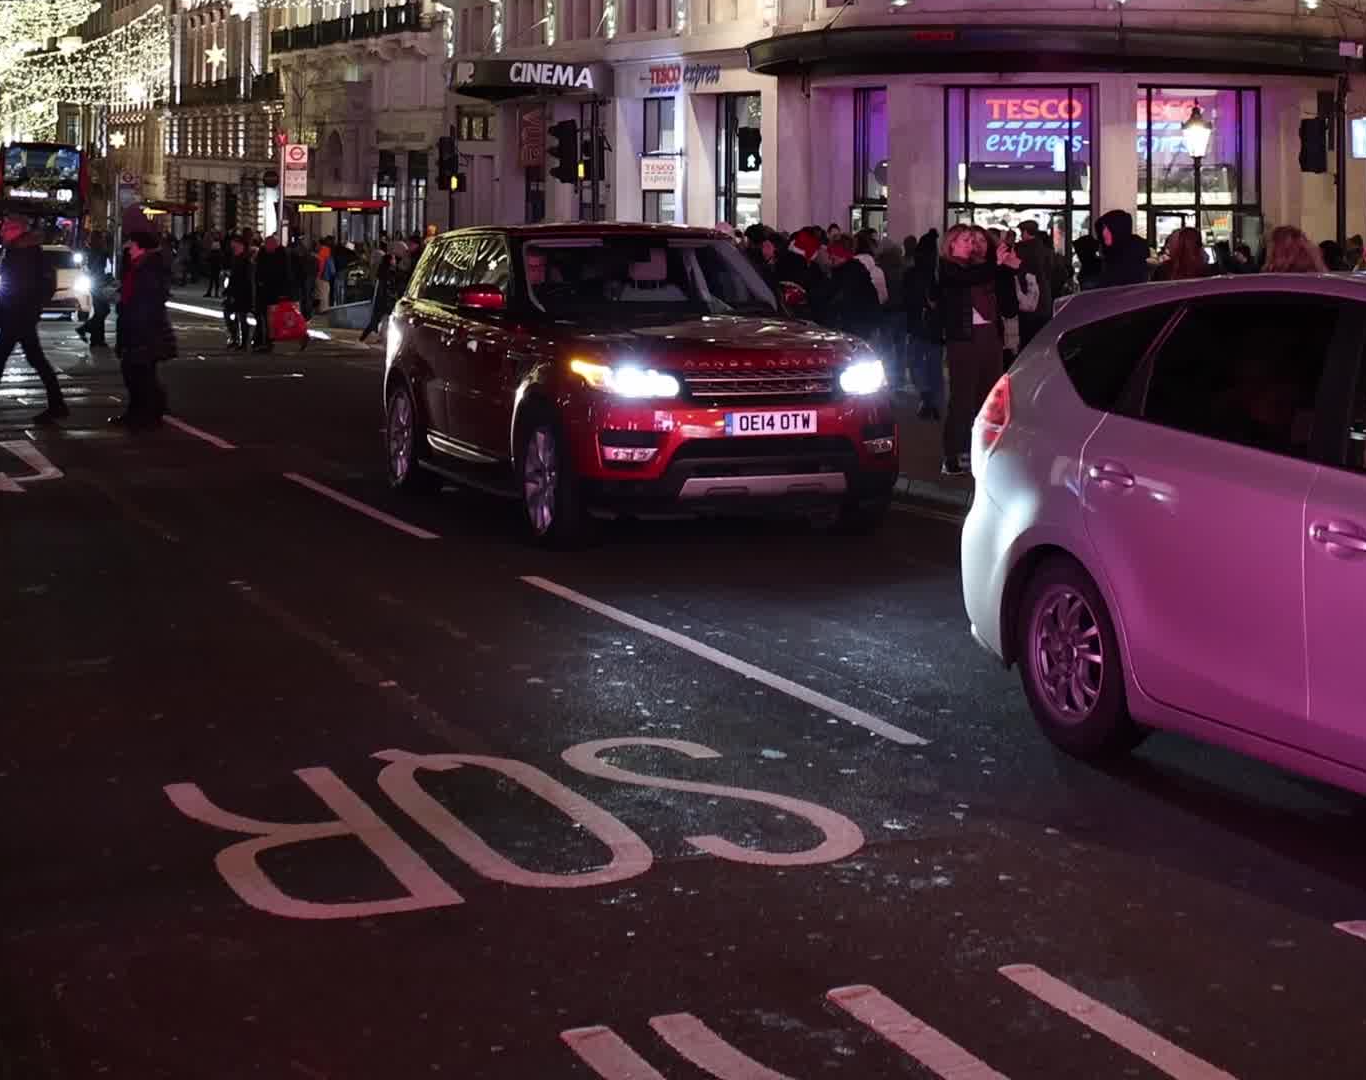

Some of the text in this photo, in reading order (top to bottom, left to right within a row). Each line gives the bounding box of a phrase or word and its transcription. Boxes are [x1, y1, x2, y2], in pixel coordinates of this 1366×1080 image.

[509, 62, 594, 89] CINEMA
[649, 65, 681, 84] TESCO
[986, 98, 1084, 120] TESCO
[643, 162, 675, 172] TESCO
[739, 413, 811, 432] OE14 OTW
[163, 737, 865, 919] SQR
